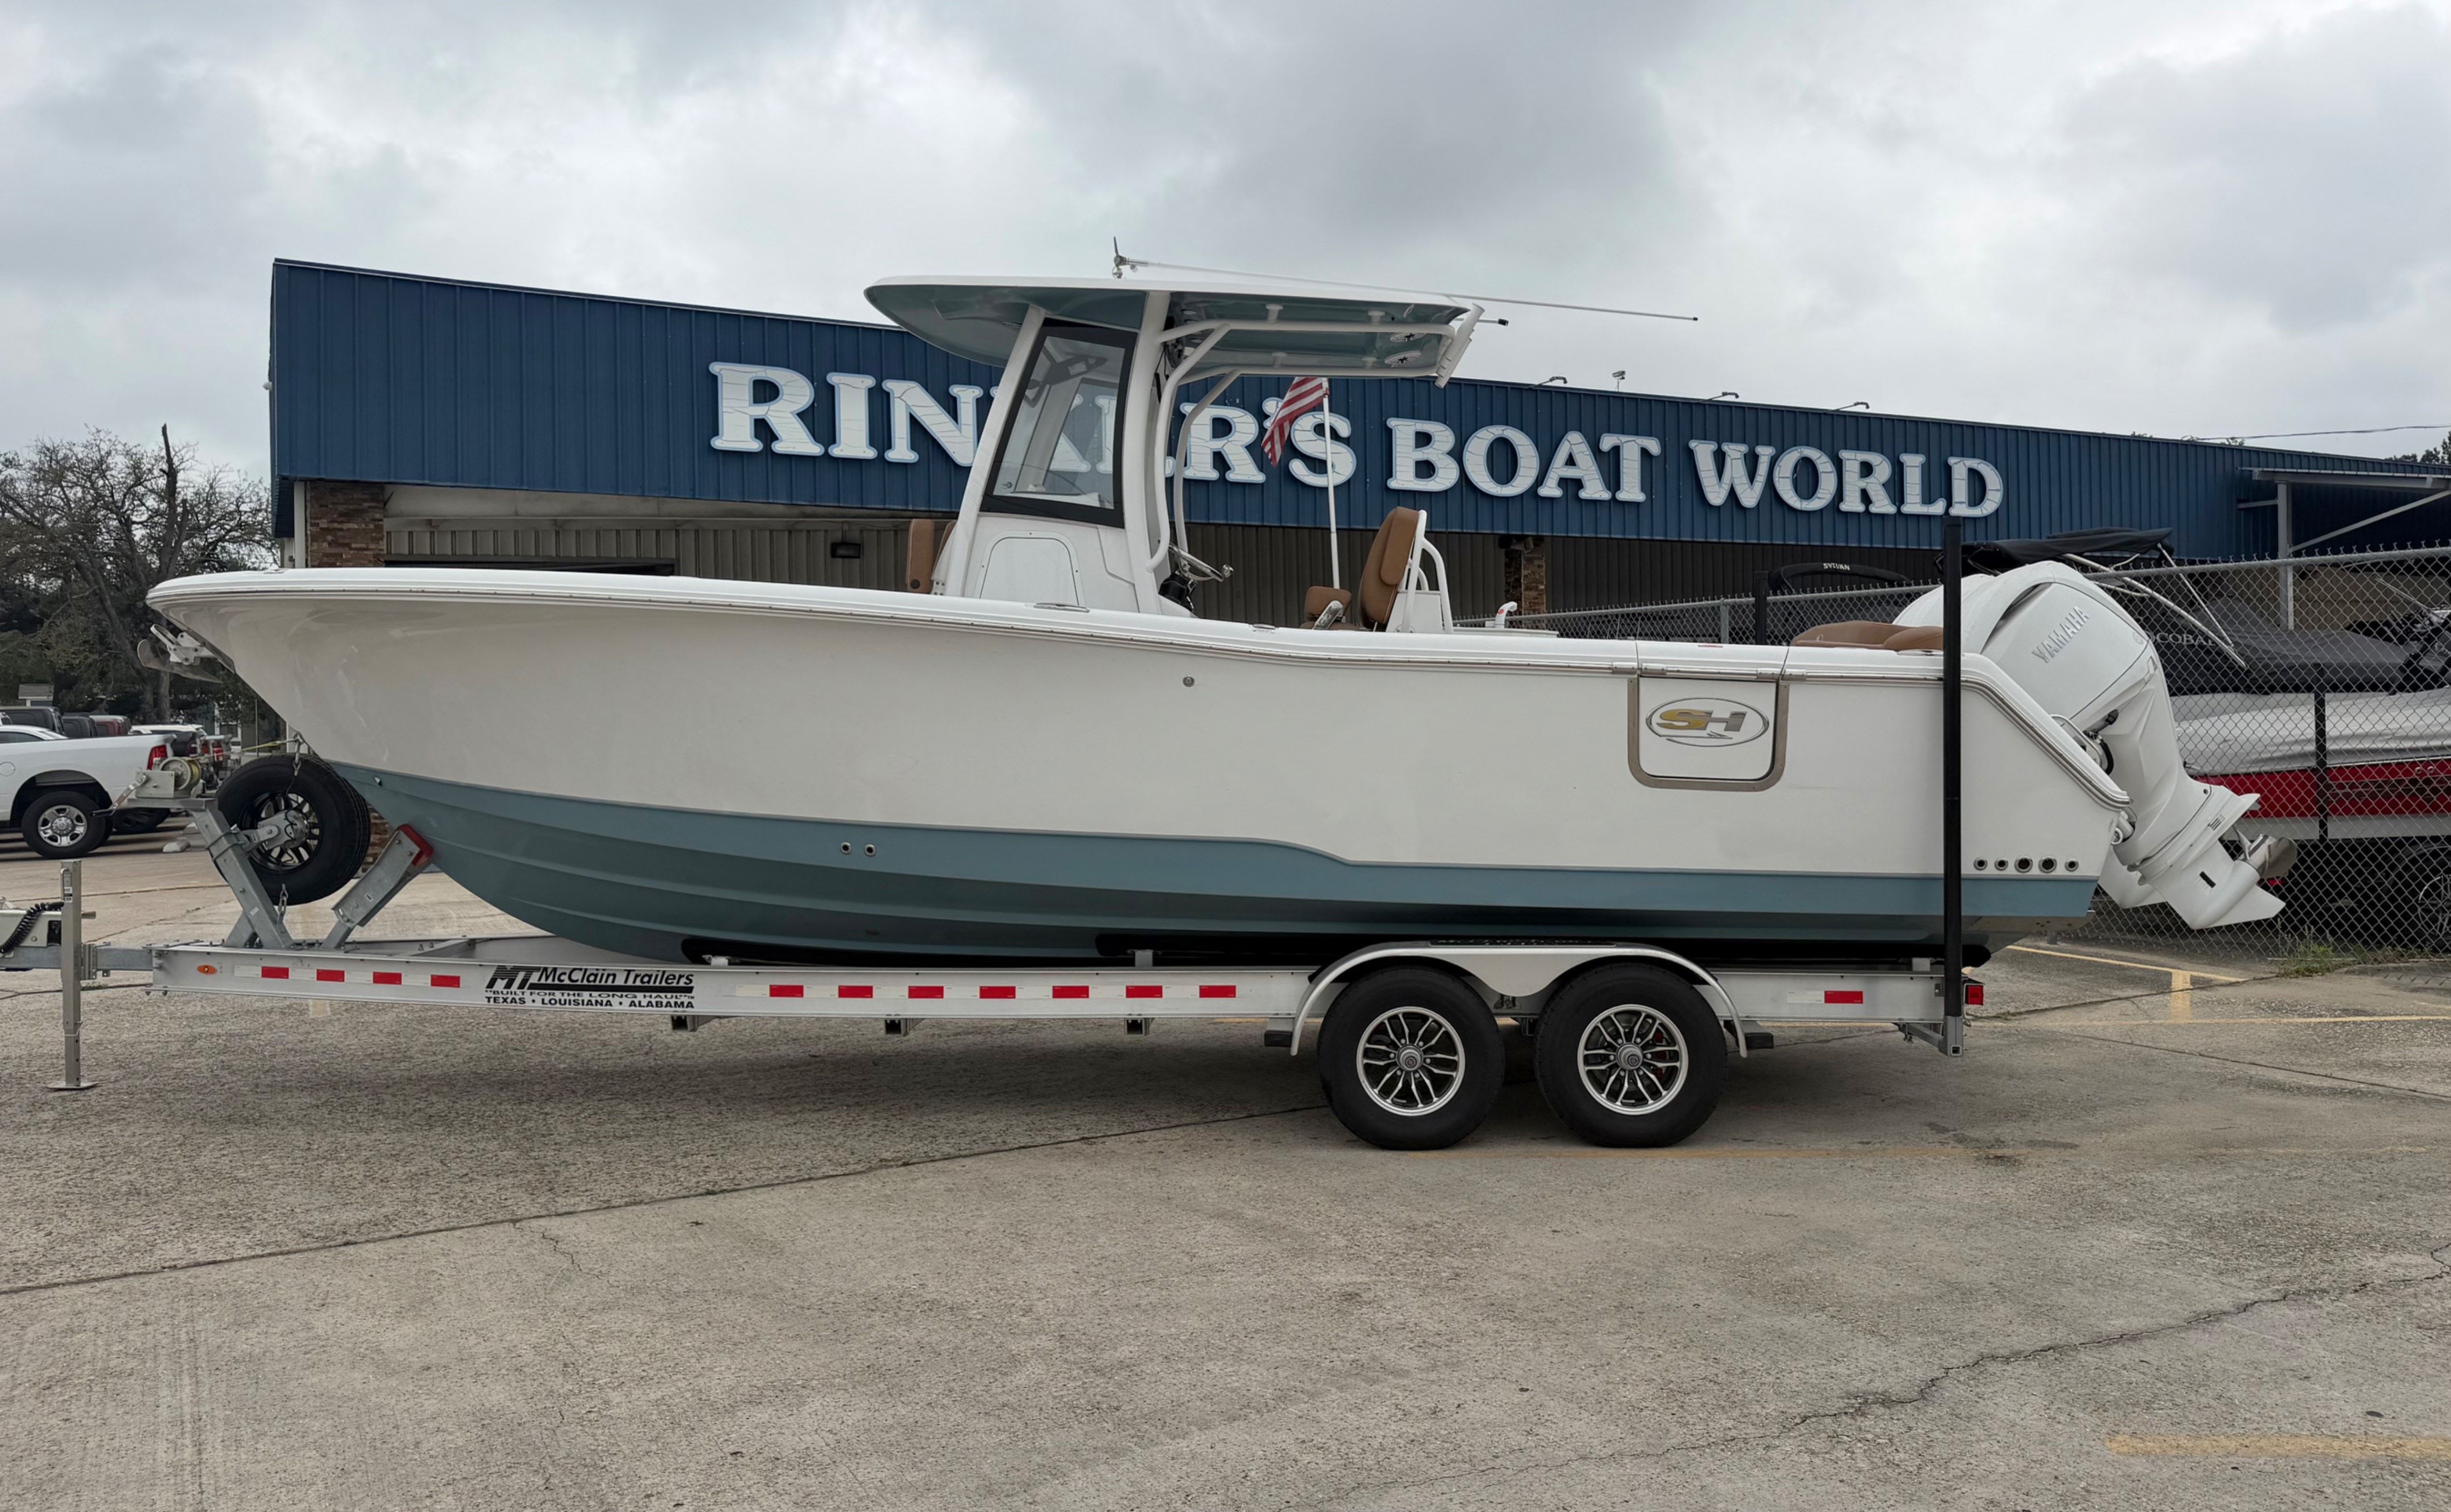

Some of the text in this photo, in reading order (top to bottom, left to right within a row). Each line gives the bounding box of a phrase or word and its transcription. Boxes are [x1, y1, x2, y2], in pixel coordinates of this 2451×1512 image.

[1386, 417, 1661, 503] BOAT
[1689, 439, 2004, 518] WORLD
[1823, 562, 1850, 571] SYLVAN
[2031, 605, 2089, 664] YAMAHA
[2156, 632, 2217, 646] COBAL
[537, 967, 695, 985] McClain Trailers
[485, 997, 695, 1009] TEXAS LOUISIANA ALABAMA
